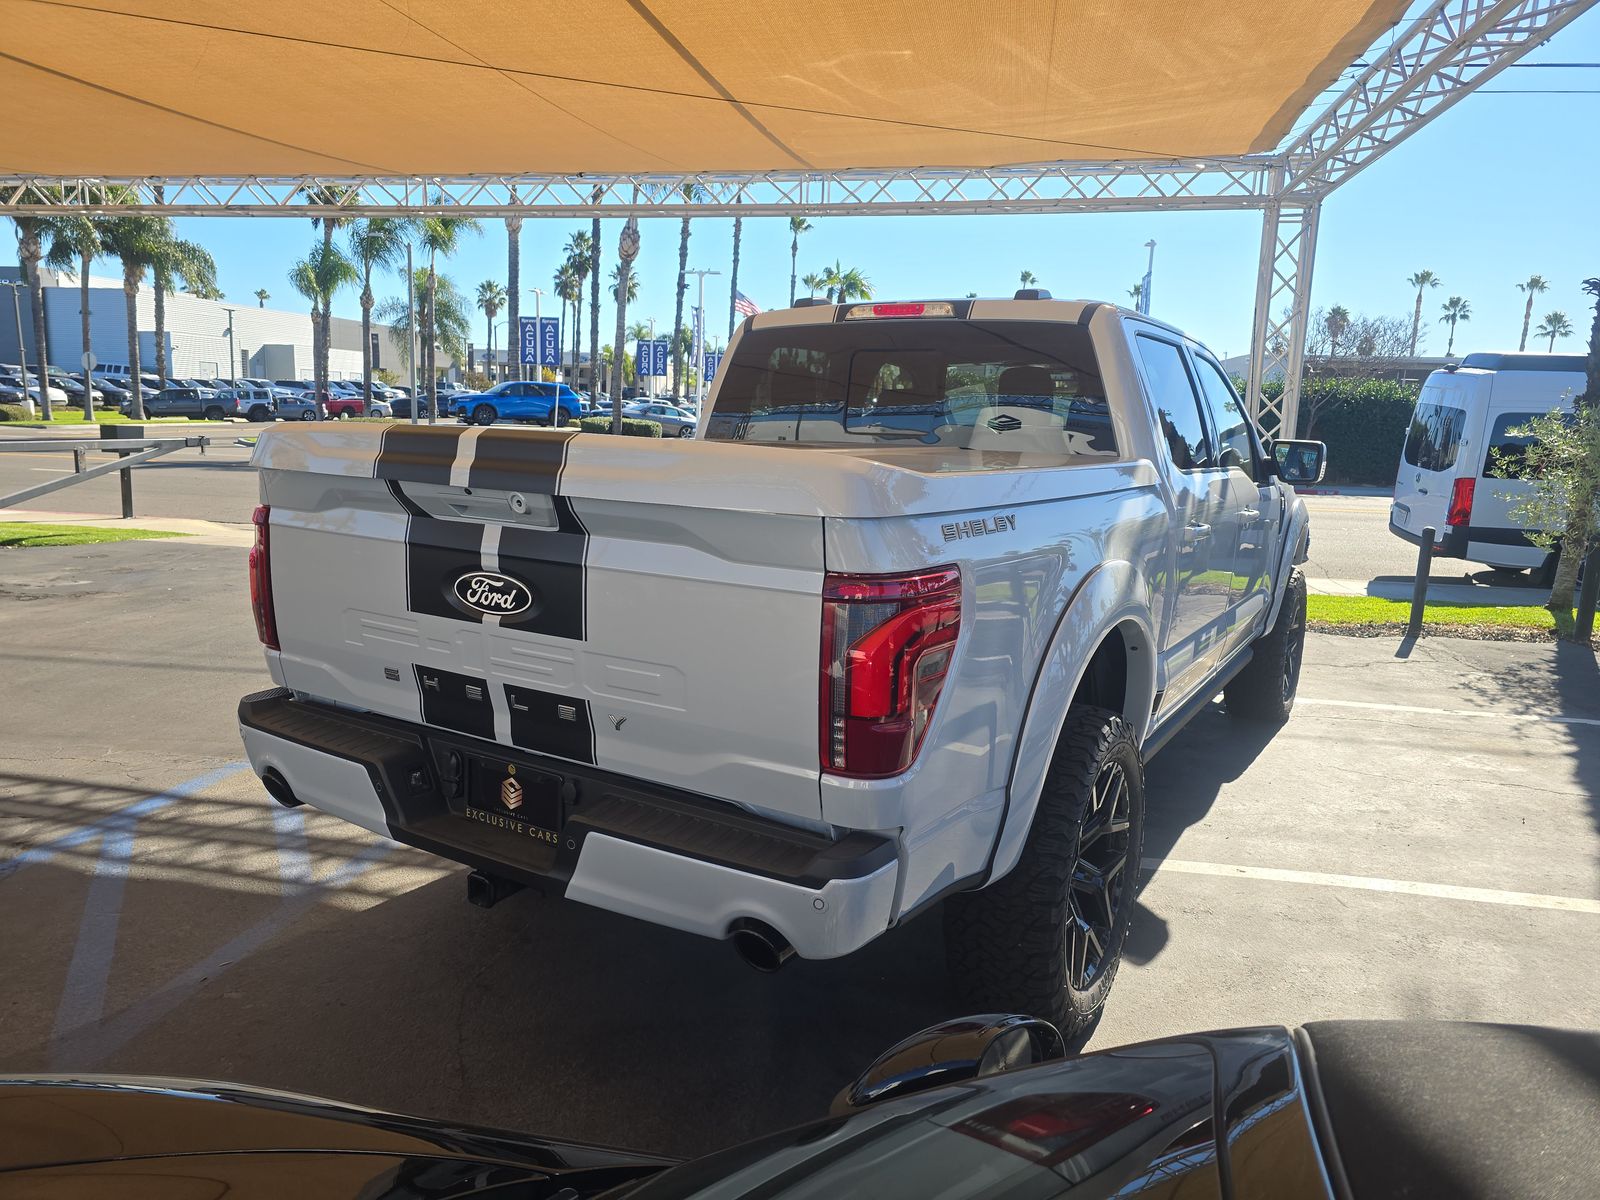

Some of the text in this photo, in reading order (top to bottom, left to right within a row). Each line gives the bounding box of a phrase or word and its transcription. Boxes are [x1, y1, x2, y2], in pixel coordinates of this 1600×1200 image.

[525, 323, 534, 362] ACURA
[545, 324, 555, 363] ACURA
[641, 345, 649, 374] ACURA
[656, 345, 664, 375] ACURA
[941, 514, 1016, 542] SHELBY
[466, 576, 517, 610] Ford
[465, 807, 523, 833] EXCLUSIVE
[529, 827, 559, 844] CARS
